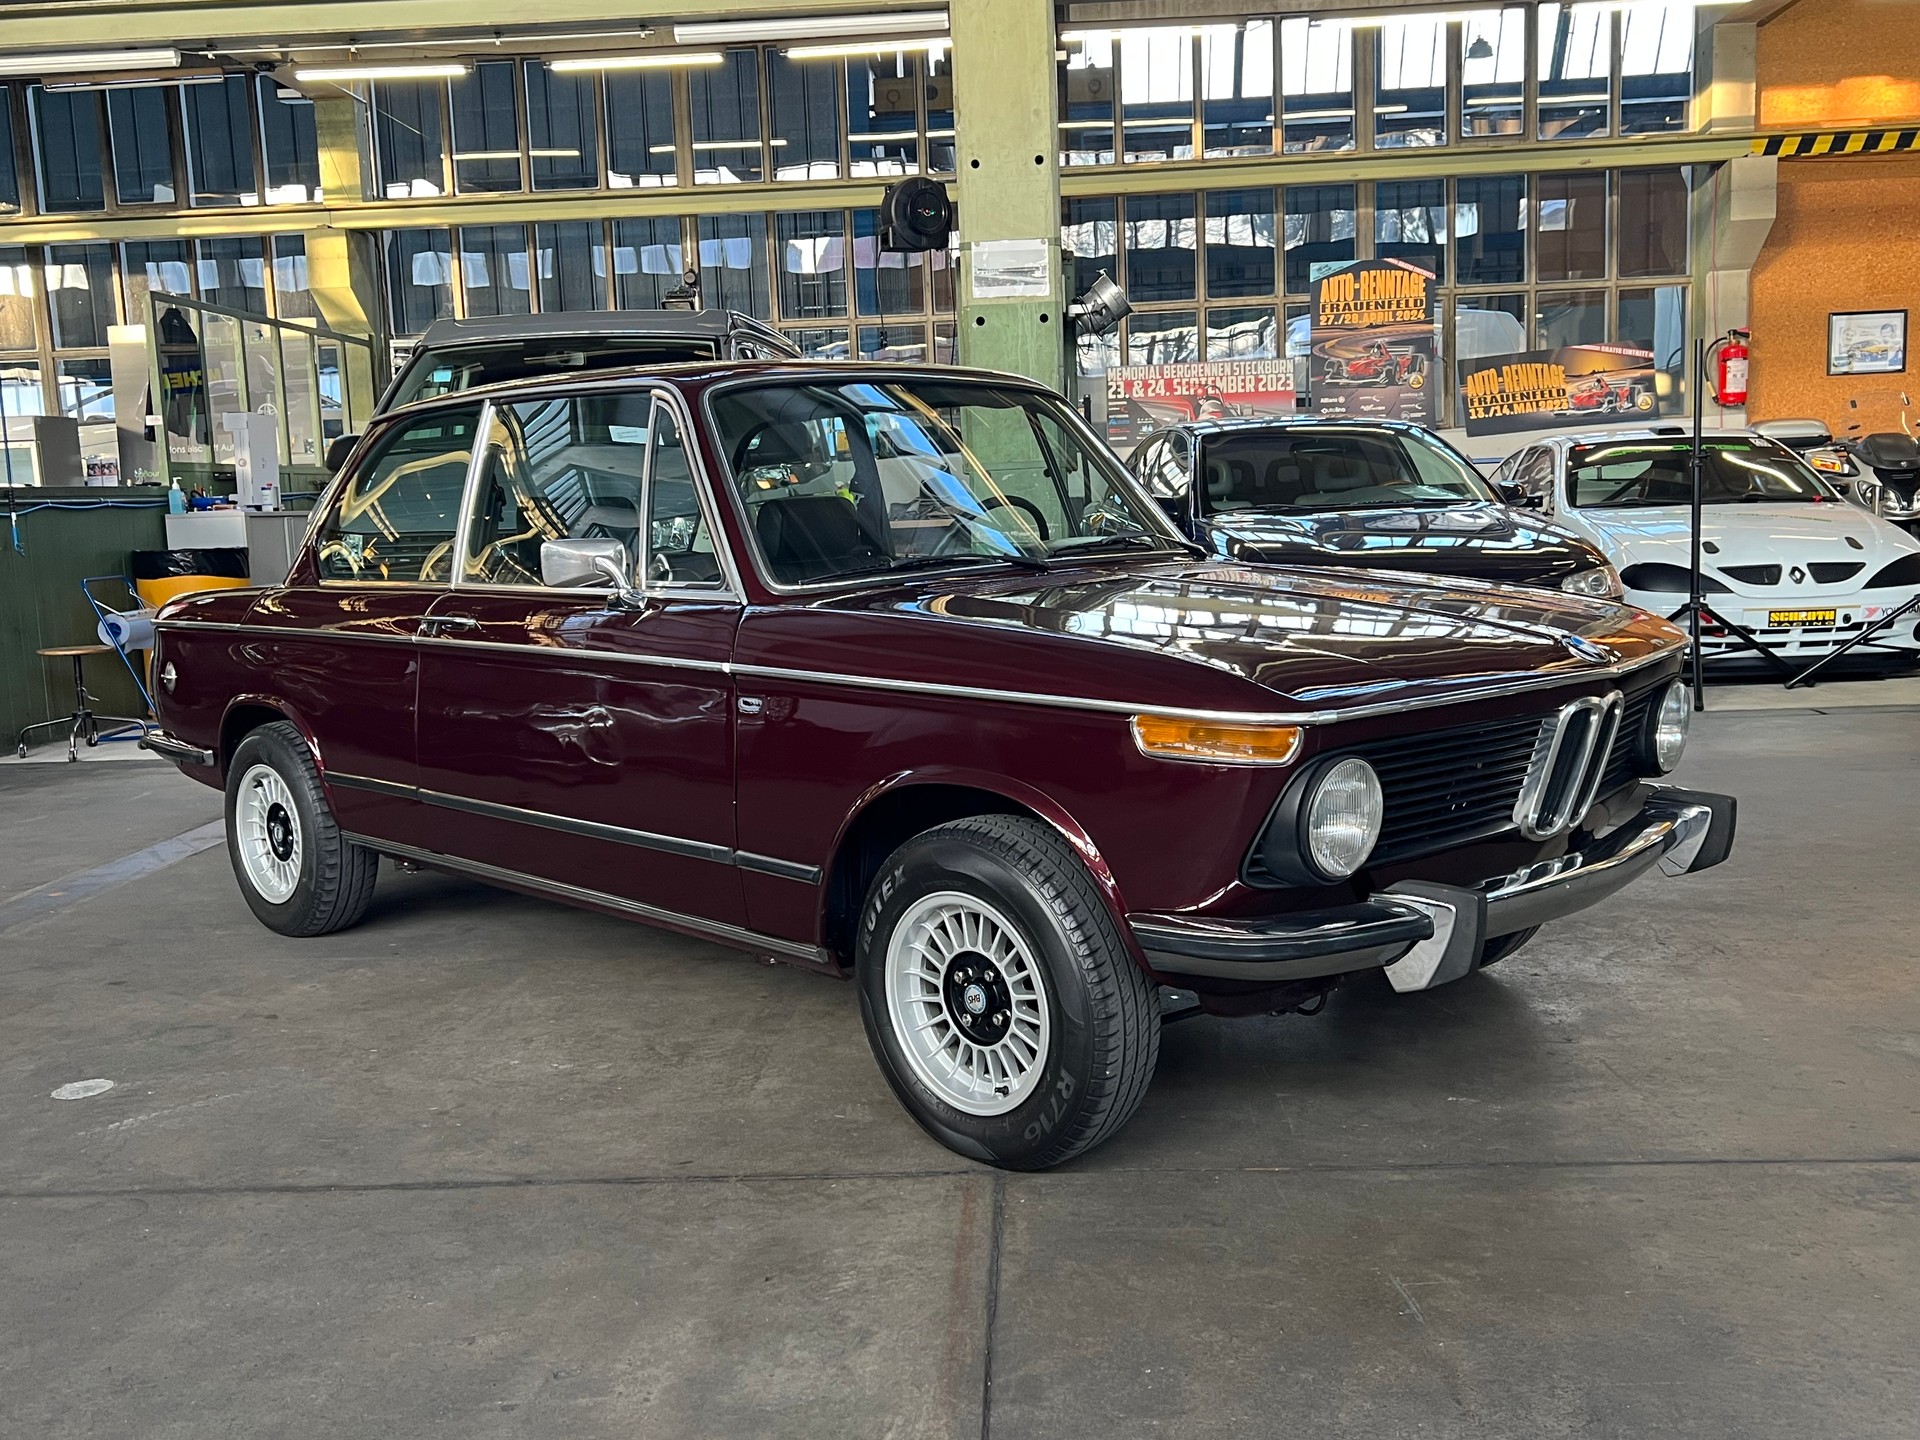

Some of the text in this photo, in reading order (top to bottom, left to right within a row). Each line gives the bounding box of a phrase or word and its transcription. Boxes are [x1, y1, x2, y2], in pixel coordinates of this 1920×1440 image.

[1320, 269, 1426, 302] AUTO-RENNTAGE
[1321, 298, 1424, 314] FRAUENFELD
[1396, 309, 1425, 321] 2024
[1107, 359, 1294, 382] MEMORIAL BERGRENNEN STECKBORN
[1467, 363, 1567, 397] AUTO-RENNTAGE
[1107, 373, 1294, 399] 23. & 24. SEPTEMBER 2023
[1469, 388, 1567, 407] FRAUENFELD
[1770, 610, 1835, 622] SCHROTH
